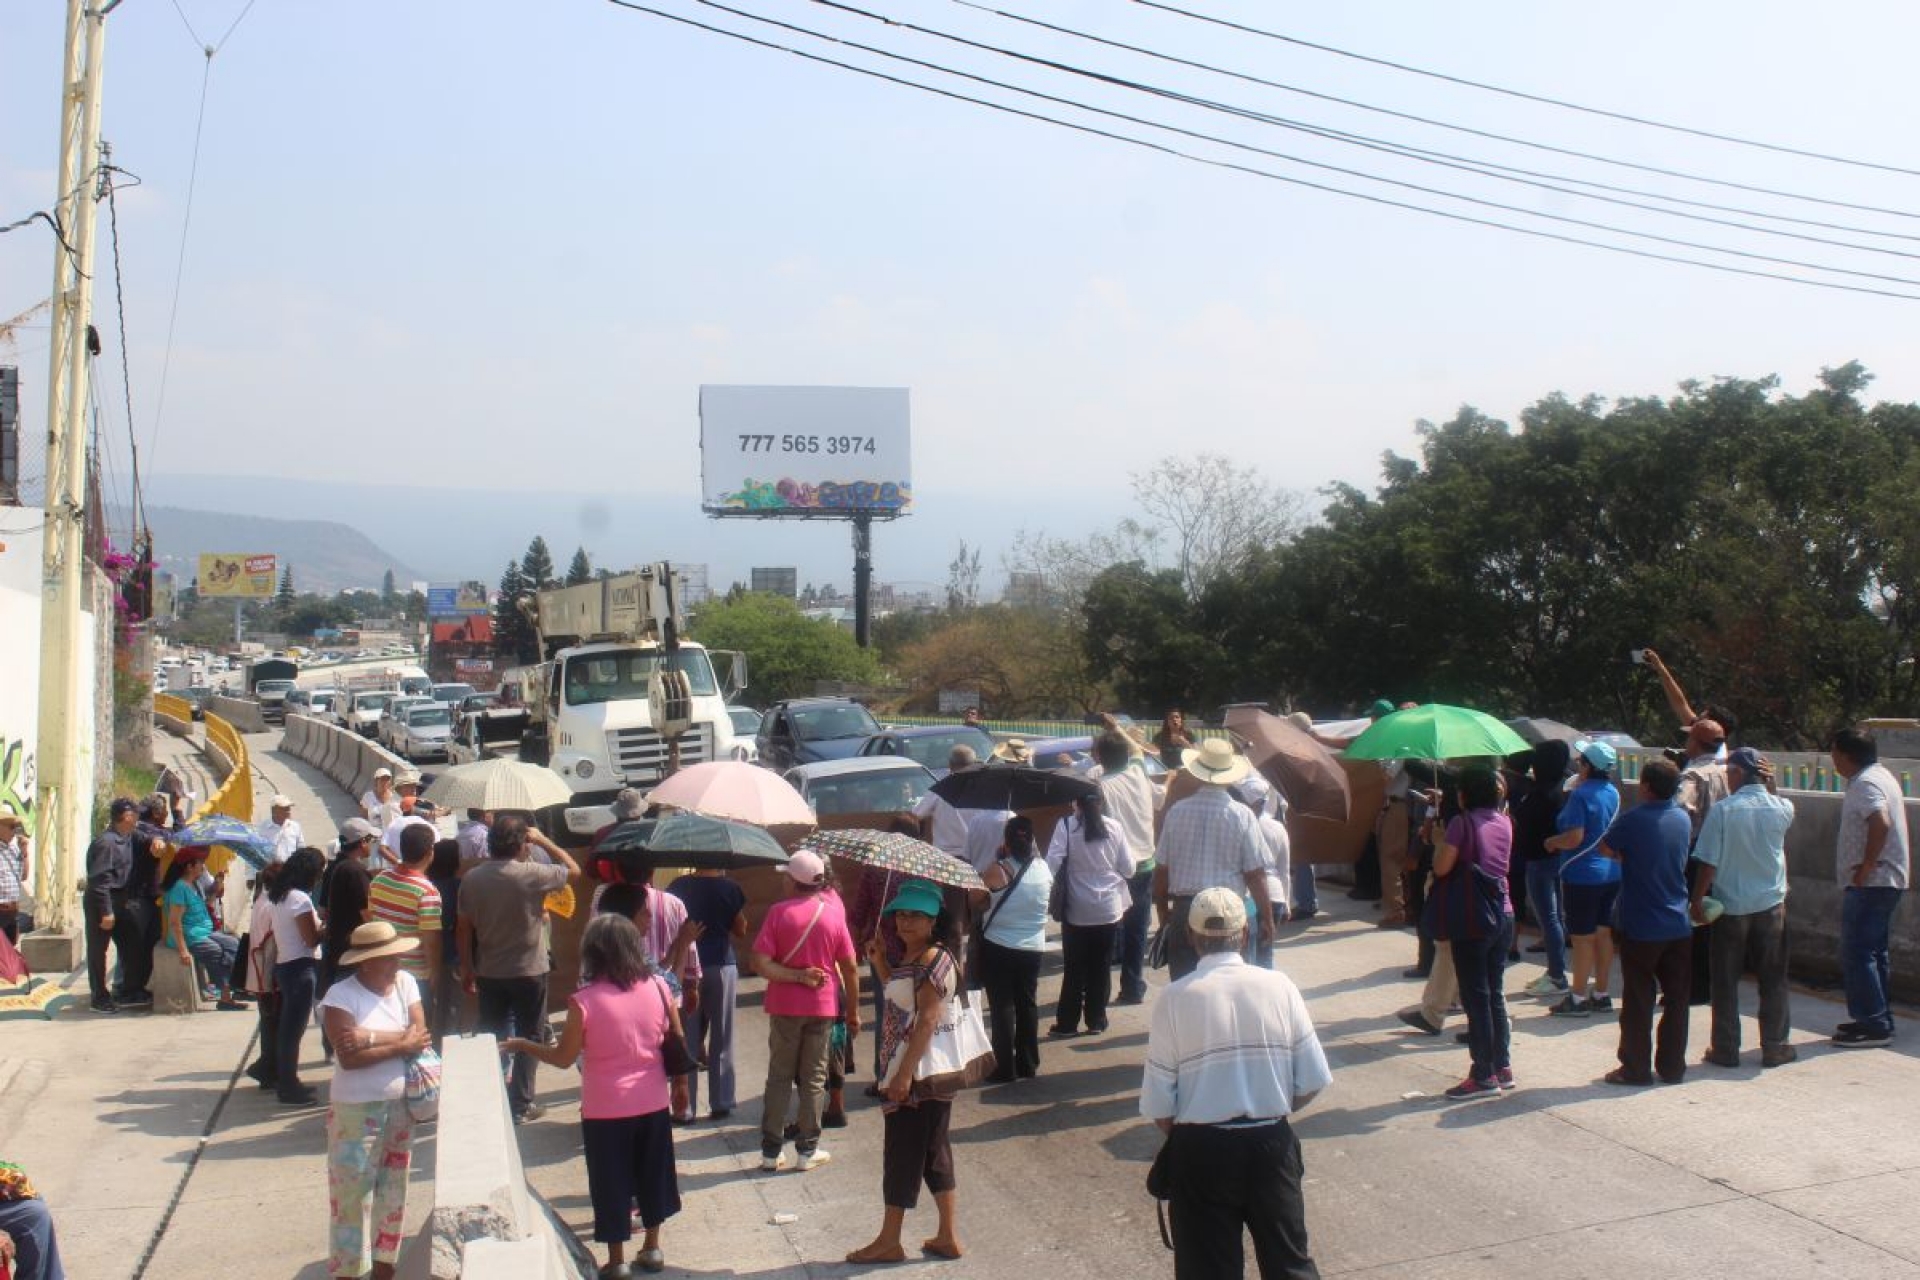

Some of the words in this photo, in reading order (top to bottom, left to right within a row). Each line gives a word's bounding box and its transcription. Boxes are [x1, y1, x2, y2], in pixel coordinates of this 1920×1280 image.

[739, 435, 775, 452] 777
[782, 435, 820, 453] 565
[827, 436, 876, 455] 3974
